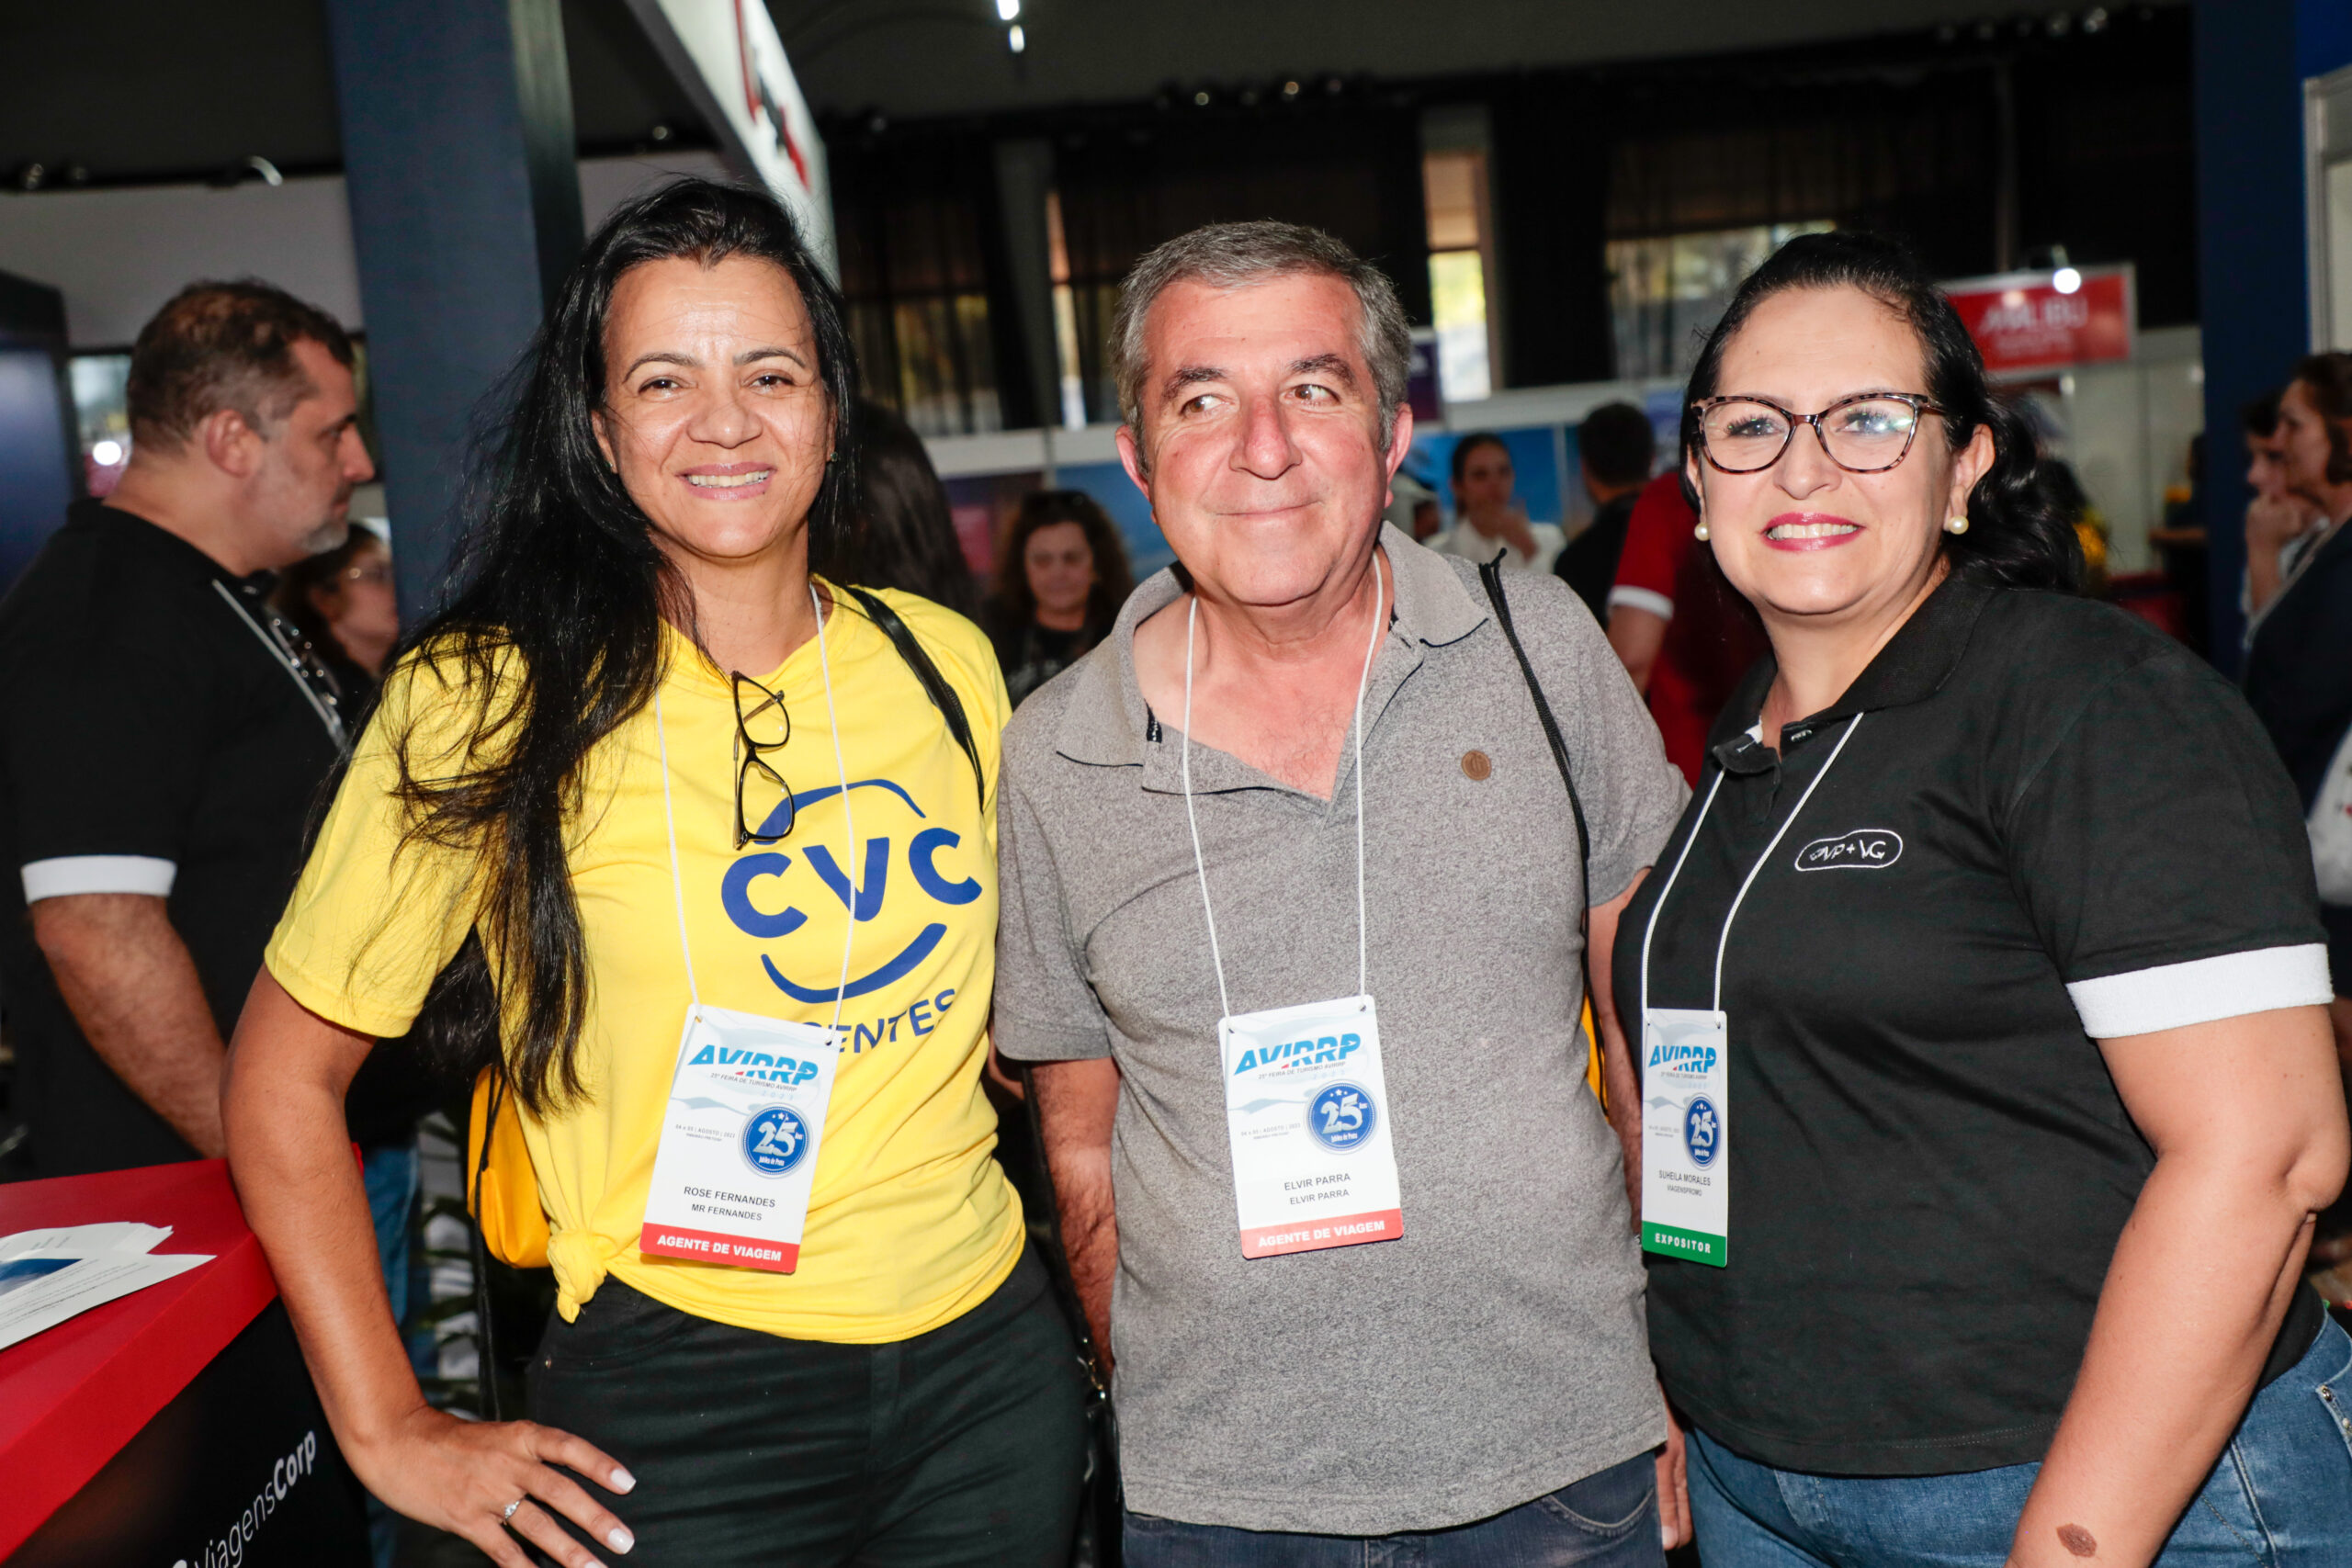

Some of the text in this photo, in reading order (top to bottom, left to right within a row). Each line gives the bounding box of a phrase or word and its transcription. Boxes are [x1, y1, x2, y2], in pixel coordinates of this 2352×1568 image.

[721, 827, 983, 938] CVC
[687, 1044, 819, 1086] AVIRRP
[1233, 1032, 1361, 1076] AVIRRP
[1648, 1045, 1716, 1073] AVIRRP
[748, 1078, 775, 1089] TURISMO
[1320, 1092, 1363, 1134] 25
[752, 1116, 798, 1156] 25
[1690, 1111, 1713, 1147] 25
[1284, 1173, 1351, 1190] ELVIR PARRA
[1658, 1169, 1712, 1186] SUHEILA MORALES
[683, 1186, 775, 1208] ROSE FERNANDES
[1290, 1189, 1350, 1205] ELVIR PARRA
[691, 1203, 763, 1221] MR FERNANDES
[1259, 1220, 1385, 1247] AGENTE DE VIAGEM
[1655, 1233, 1712, 1254] EXPOSITOR
[657, 1235, 782, 1261] AGENTE DE VIAGEM
